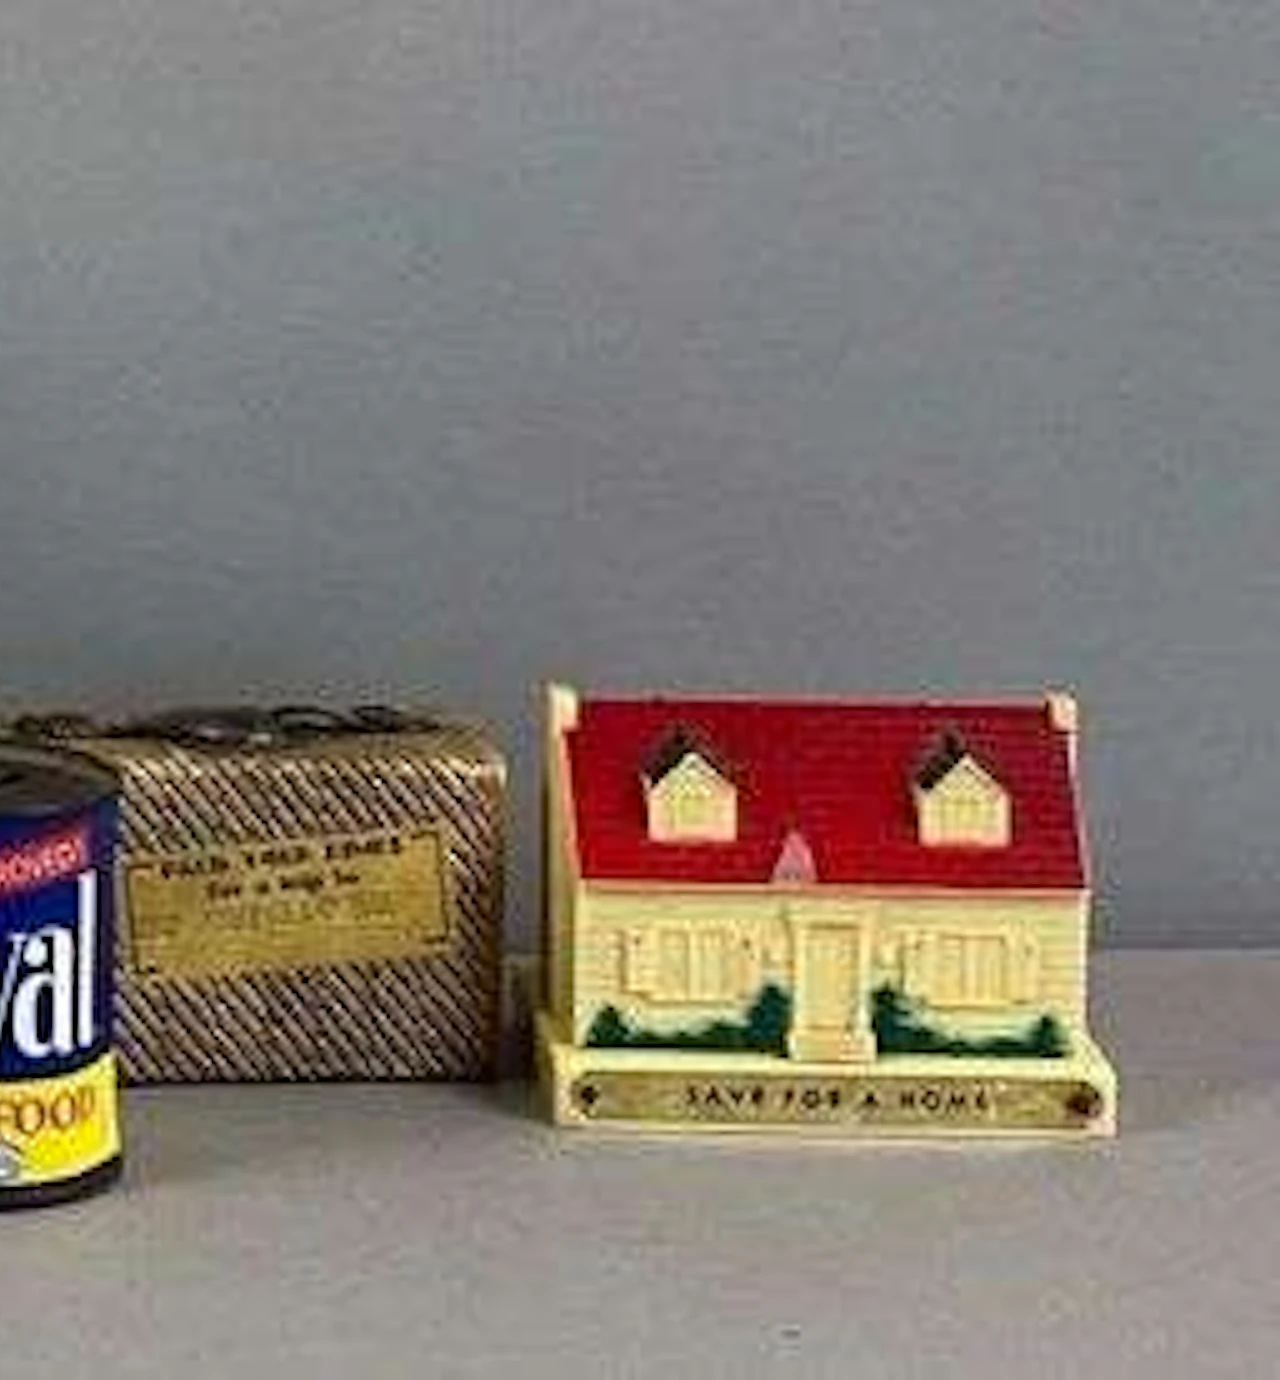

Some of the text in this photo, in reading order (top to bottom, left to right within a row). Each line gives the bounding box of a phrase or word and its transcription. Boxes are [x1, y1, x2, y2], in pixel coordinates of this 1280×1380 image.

[688, 1085, 988, 1111] SAVE FOR A HOME
